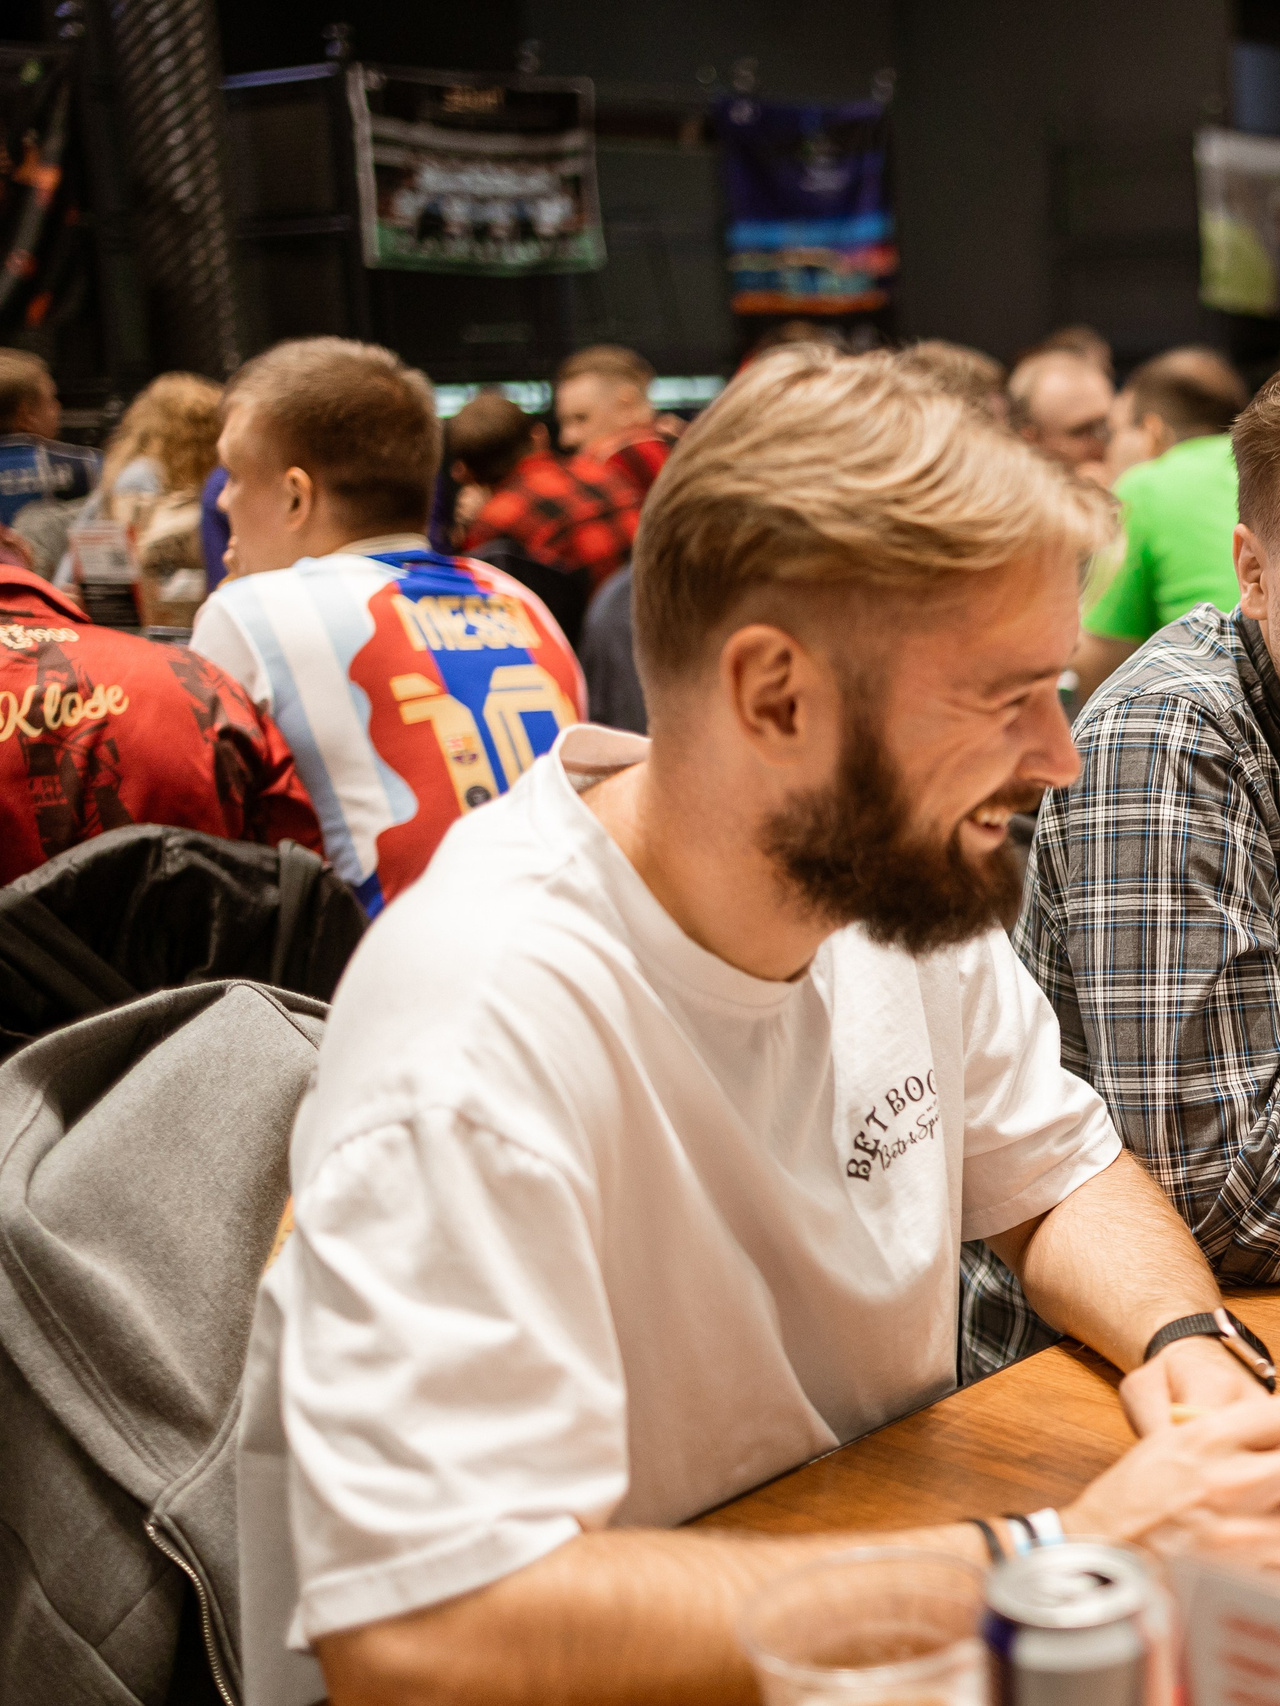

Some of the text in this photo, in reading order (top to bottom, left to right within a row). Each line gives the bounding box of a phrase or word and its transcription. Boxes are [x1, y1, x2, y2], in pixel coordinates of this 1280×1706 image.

[390, 594, 542, 651] MESSI
[0, 682, 130, 741] Klose
[846, 1105, 888, 1182] BET
